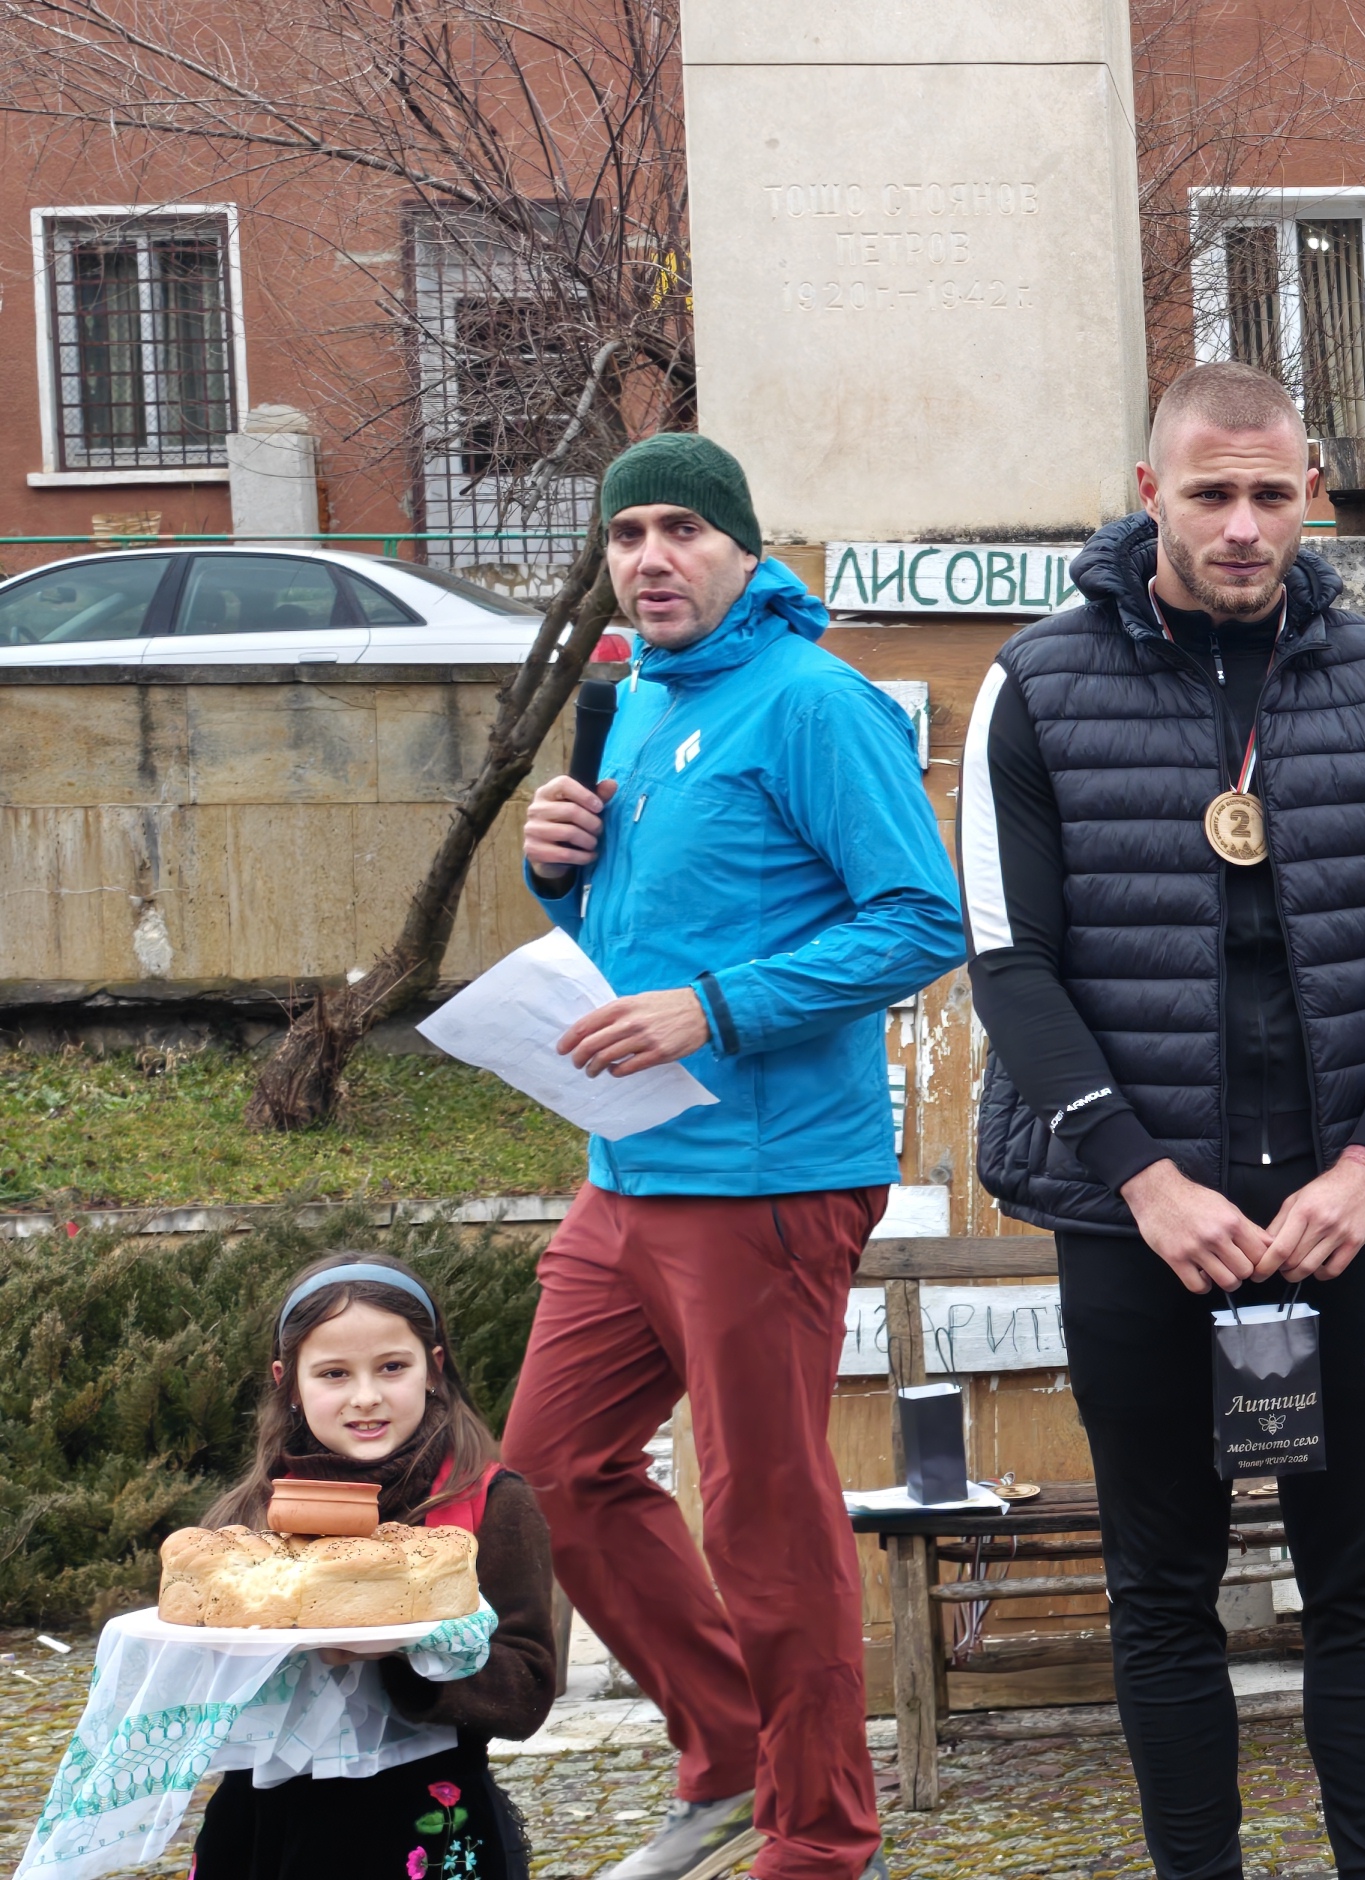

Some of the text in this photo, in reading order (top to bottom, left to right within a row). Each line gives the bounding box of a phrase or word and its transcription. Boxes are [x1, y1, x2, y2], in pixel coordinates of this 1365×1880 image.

[763, 182, 1040, 218] ТОШО СТОЯНОВ
[836, 231, 971, 266] ПЕТРОВ
[1230, 809, 1251, 838] 2
[1225, 1391, 1318, 1416] Липница
[1226, 1435, 1319, 1453] меденото село
[1238, 1459, 1264, 1469] Honey
[1288, 1454, 1309, 1464] 2026
